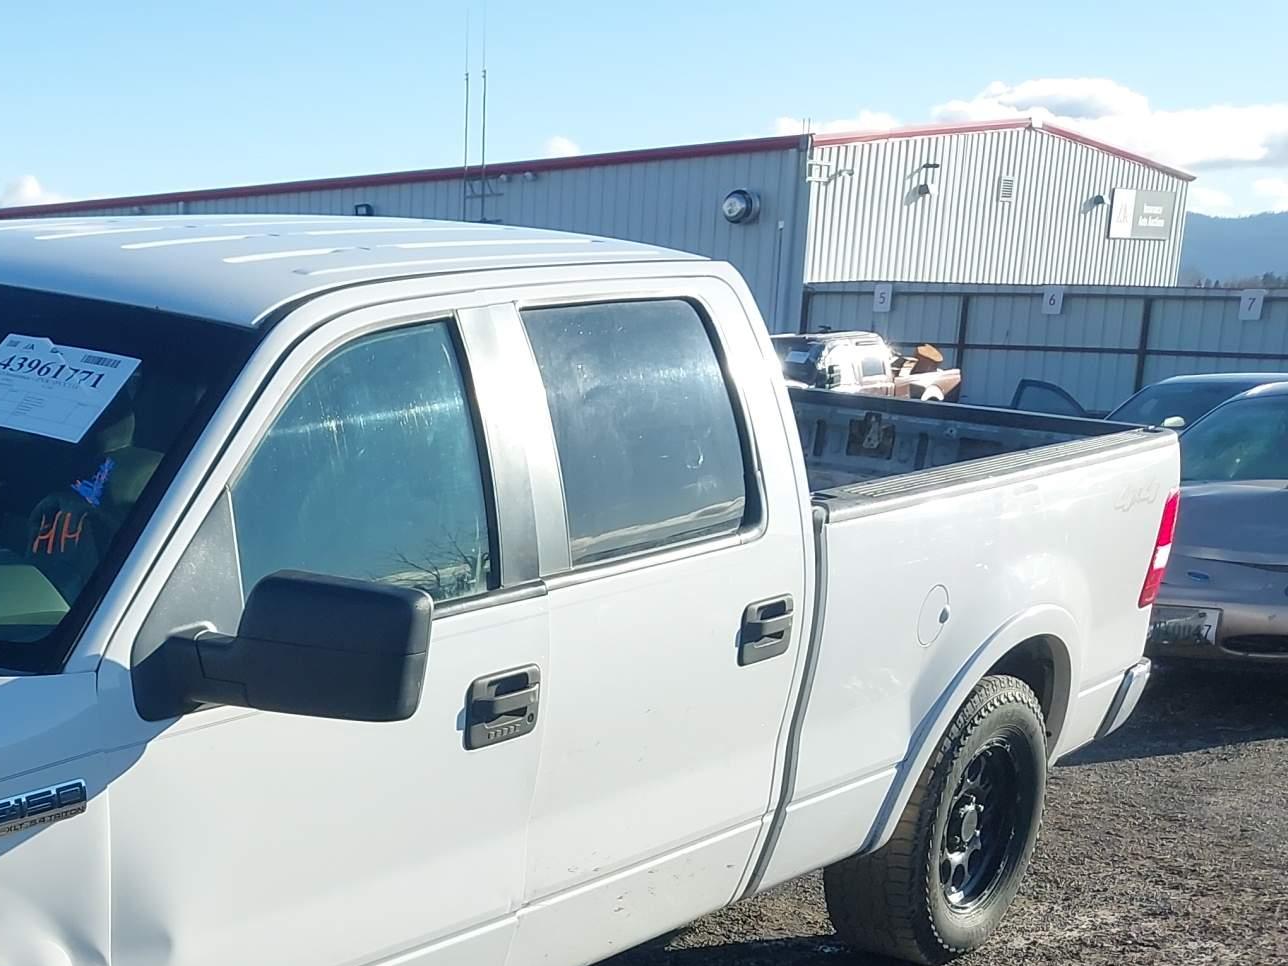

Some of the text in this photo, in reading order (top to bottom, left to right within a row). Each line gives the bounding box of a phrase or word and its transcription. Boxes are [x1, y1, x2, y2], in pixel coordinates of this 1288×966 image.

[879, 292, 886, 305] 5
[1048, 294, 1056, 306] 6
[1248, 297, 1256, 311] 7
[0, 354, 105, 389] 43961771
[6, 822, 25, 833] XLT
[47, 805, 86, 823] TRITON
